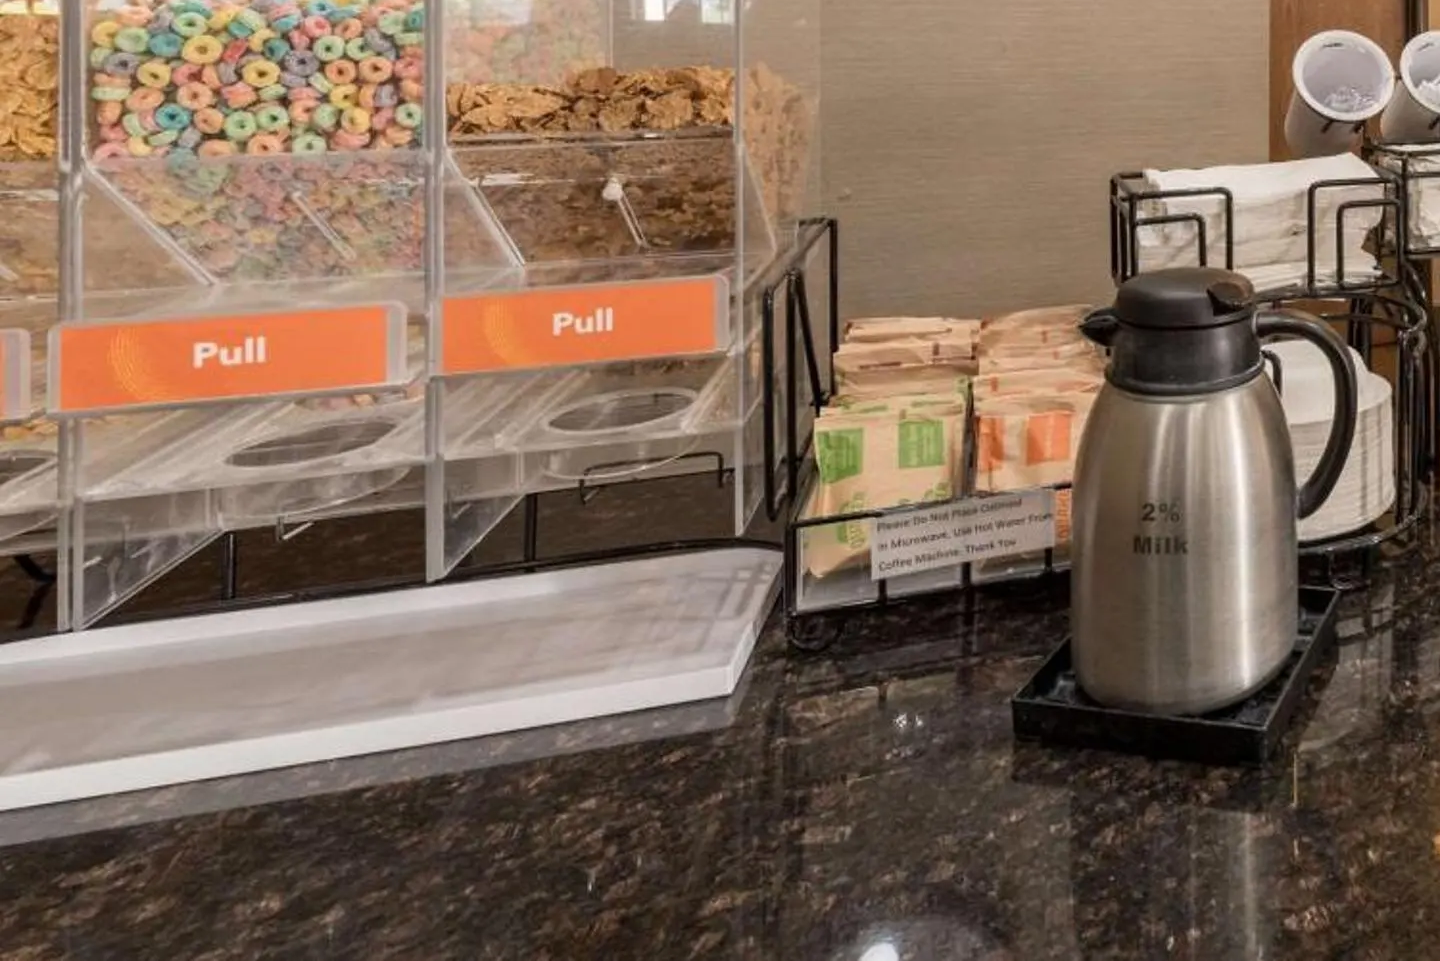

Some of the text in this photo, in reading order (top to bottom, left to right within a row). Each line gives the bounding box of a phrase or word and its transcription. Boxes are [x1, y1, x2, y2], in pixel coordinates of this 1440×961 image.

[553, 307, 613, 336] Pull
[193, 336, 266, 369] Pull
[1141, 502, 1181, 523] 2%
[1133, 535, 1188, 555] Milk
